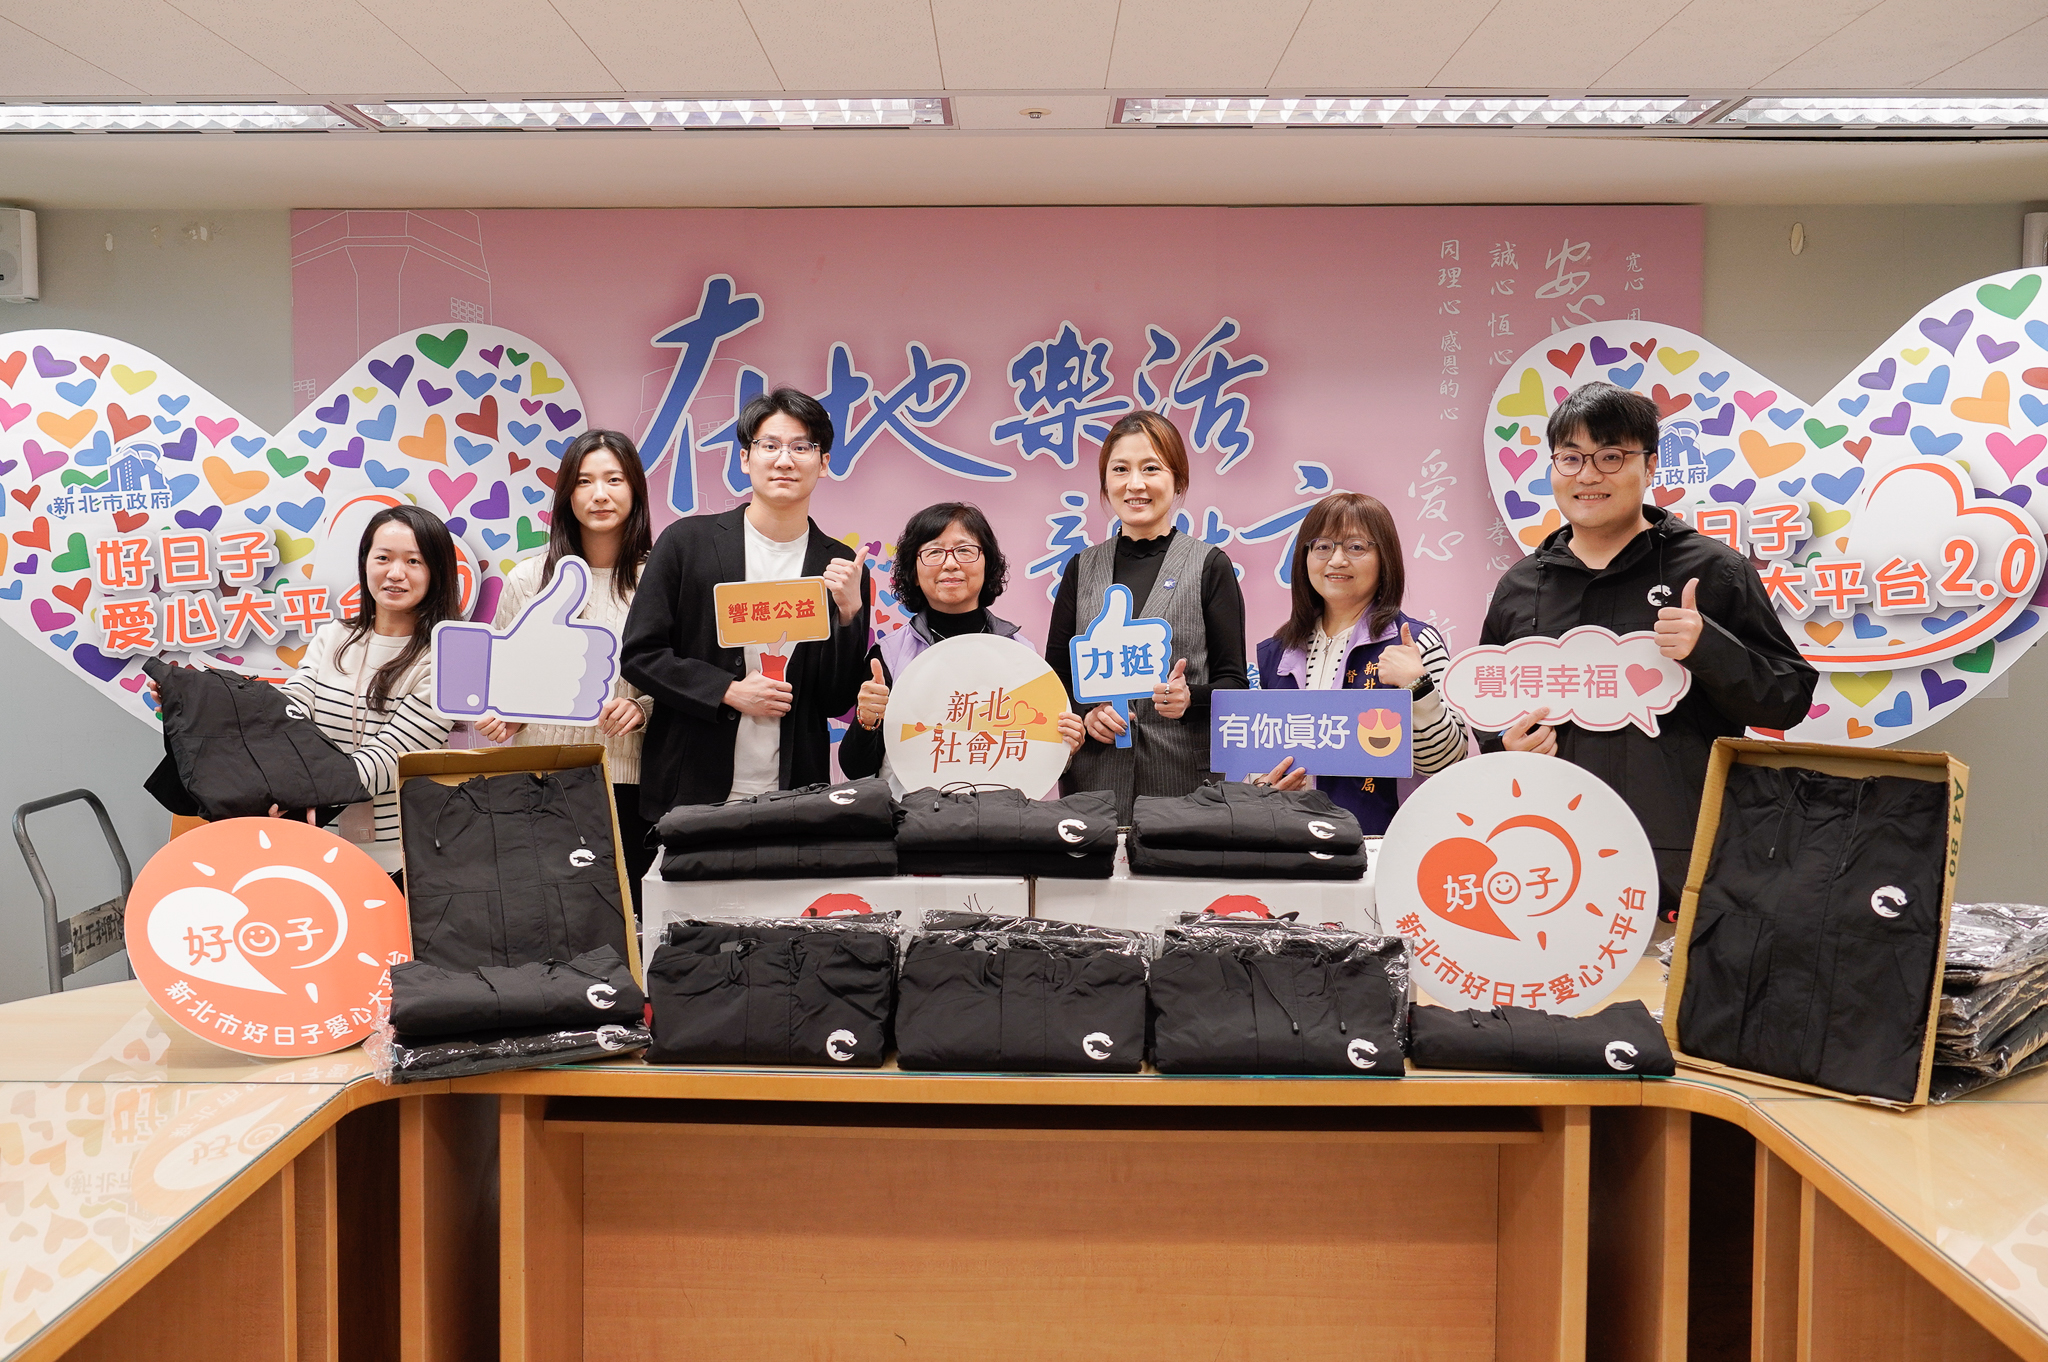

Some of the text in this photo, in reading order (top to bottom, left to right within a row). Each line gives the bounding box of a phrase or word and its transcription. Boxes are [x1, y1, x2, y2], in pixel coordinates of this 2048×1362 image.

[1489, 241, 1519, 295] 誠心
[1438, 239, 1462, 421] 同理心 感恩的心
[640, 273, 1267, 513] 在地樂活
[53, 491, 171, 515] 新北市政府
[1407, 448, 1465, 562] 愛心
[1676, 504, 1803, 554] 日子
[96, 532, 272, 588] 好日子
[1761, 536, 2037, 613] 大平台 2.0
[728, 599, 815, 623] 響應公益
[1082, 642, 1154, 680] 力挺
[1473, 663, 1619, 700] 覺得幸福
[946, 688, 1012, 731] 新北
[930, 728, 1027, 773] 社會局
[1948, 777, 1964, 877] A4 80
[1396, 886, 1648, 1007] 新北市好日子愛心大平台
